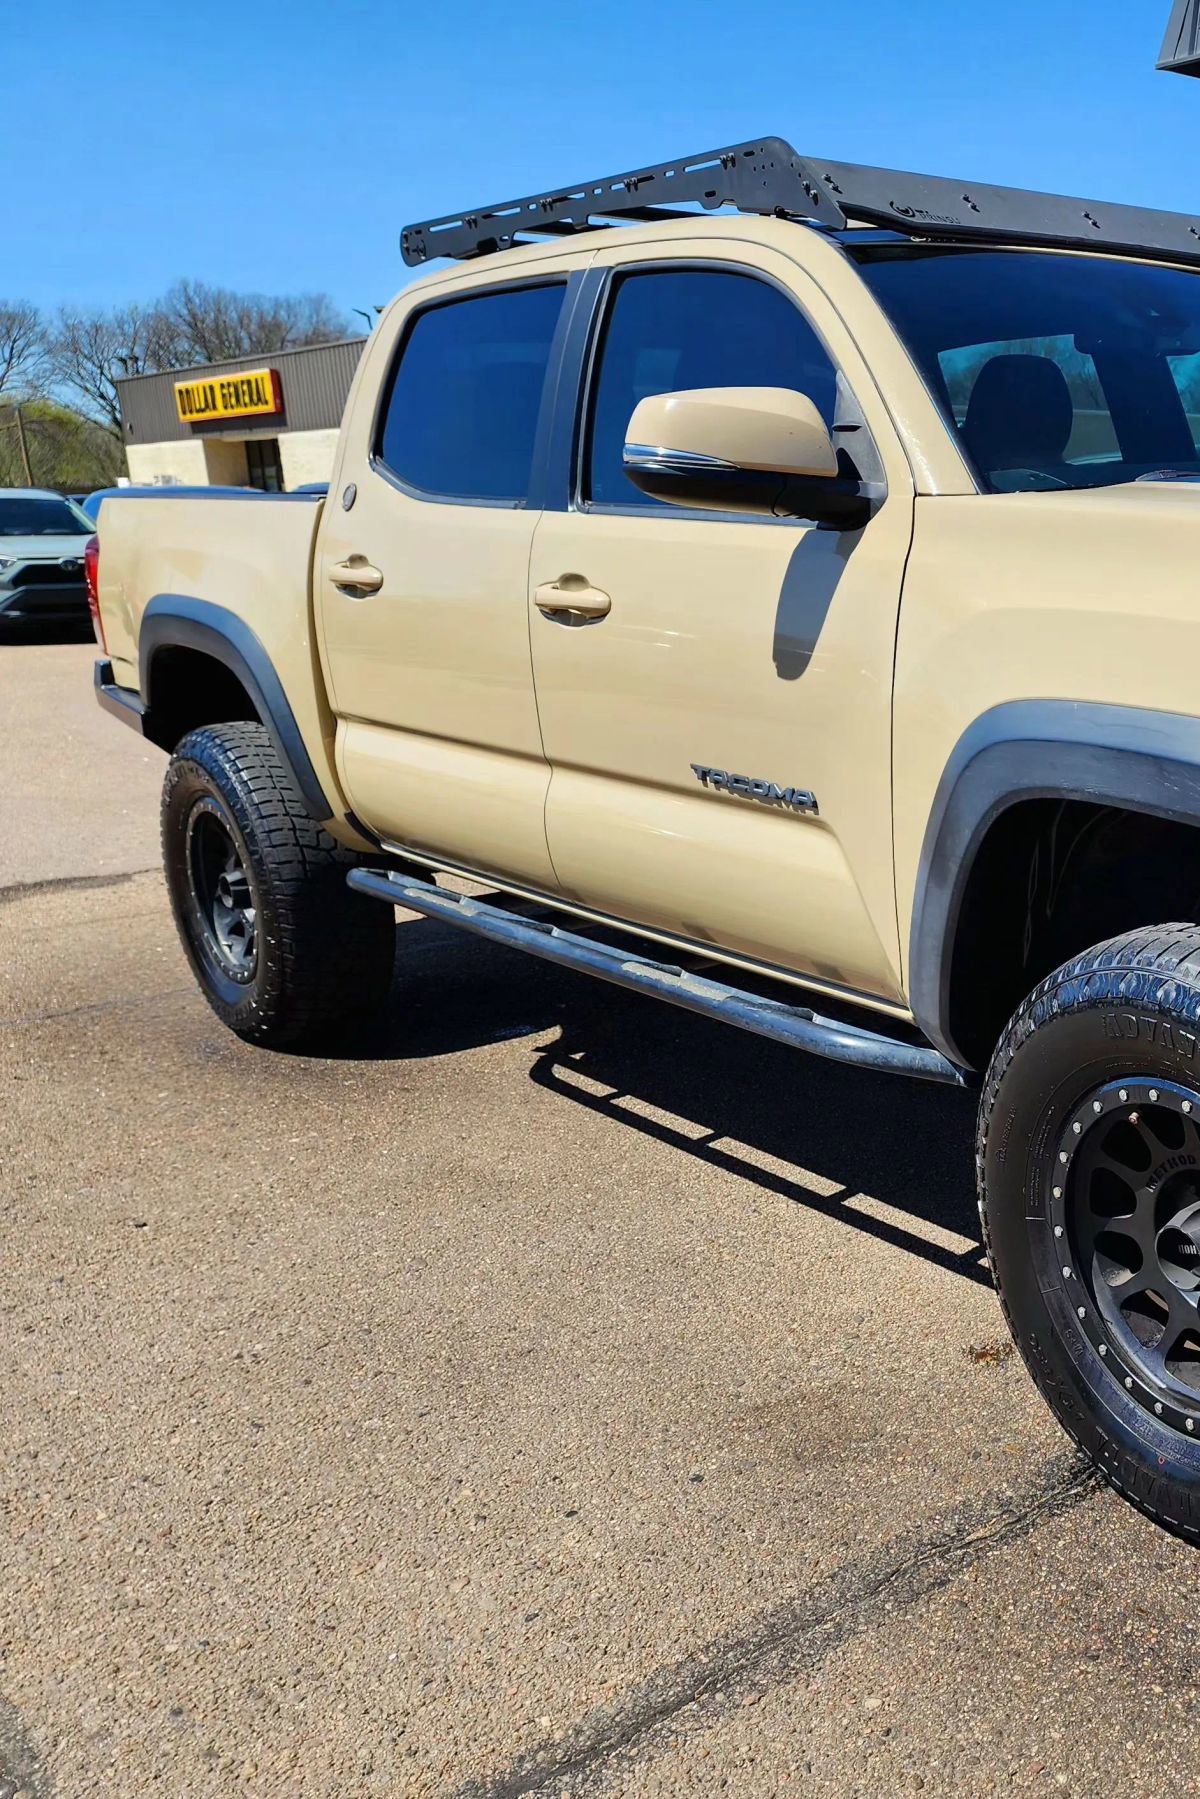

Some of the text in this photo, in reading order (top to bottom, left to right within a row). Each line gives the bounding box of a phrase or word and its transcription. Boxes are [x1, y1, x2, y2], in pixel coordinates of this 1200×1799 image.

[178, 377, 268, 415] DOLLAR GENERAL
[690, 763, 818, 808] TACOMA
[1145, 1154, 1197, 1193] METHOD
